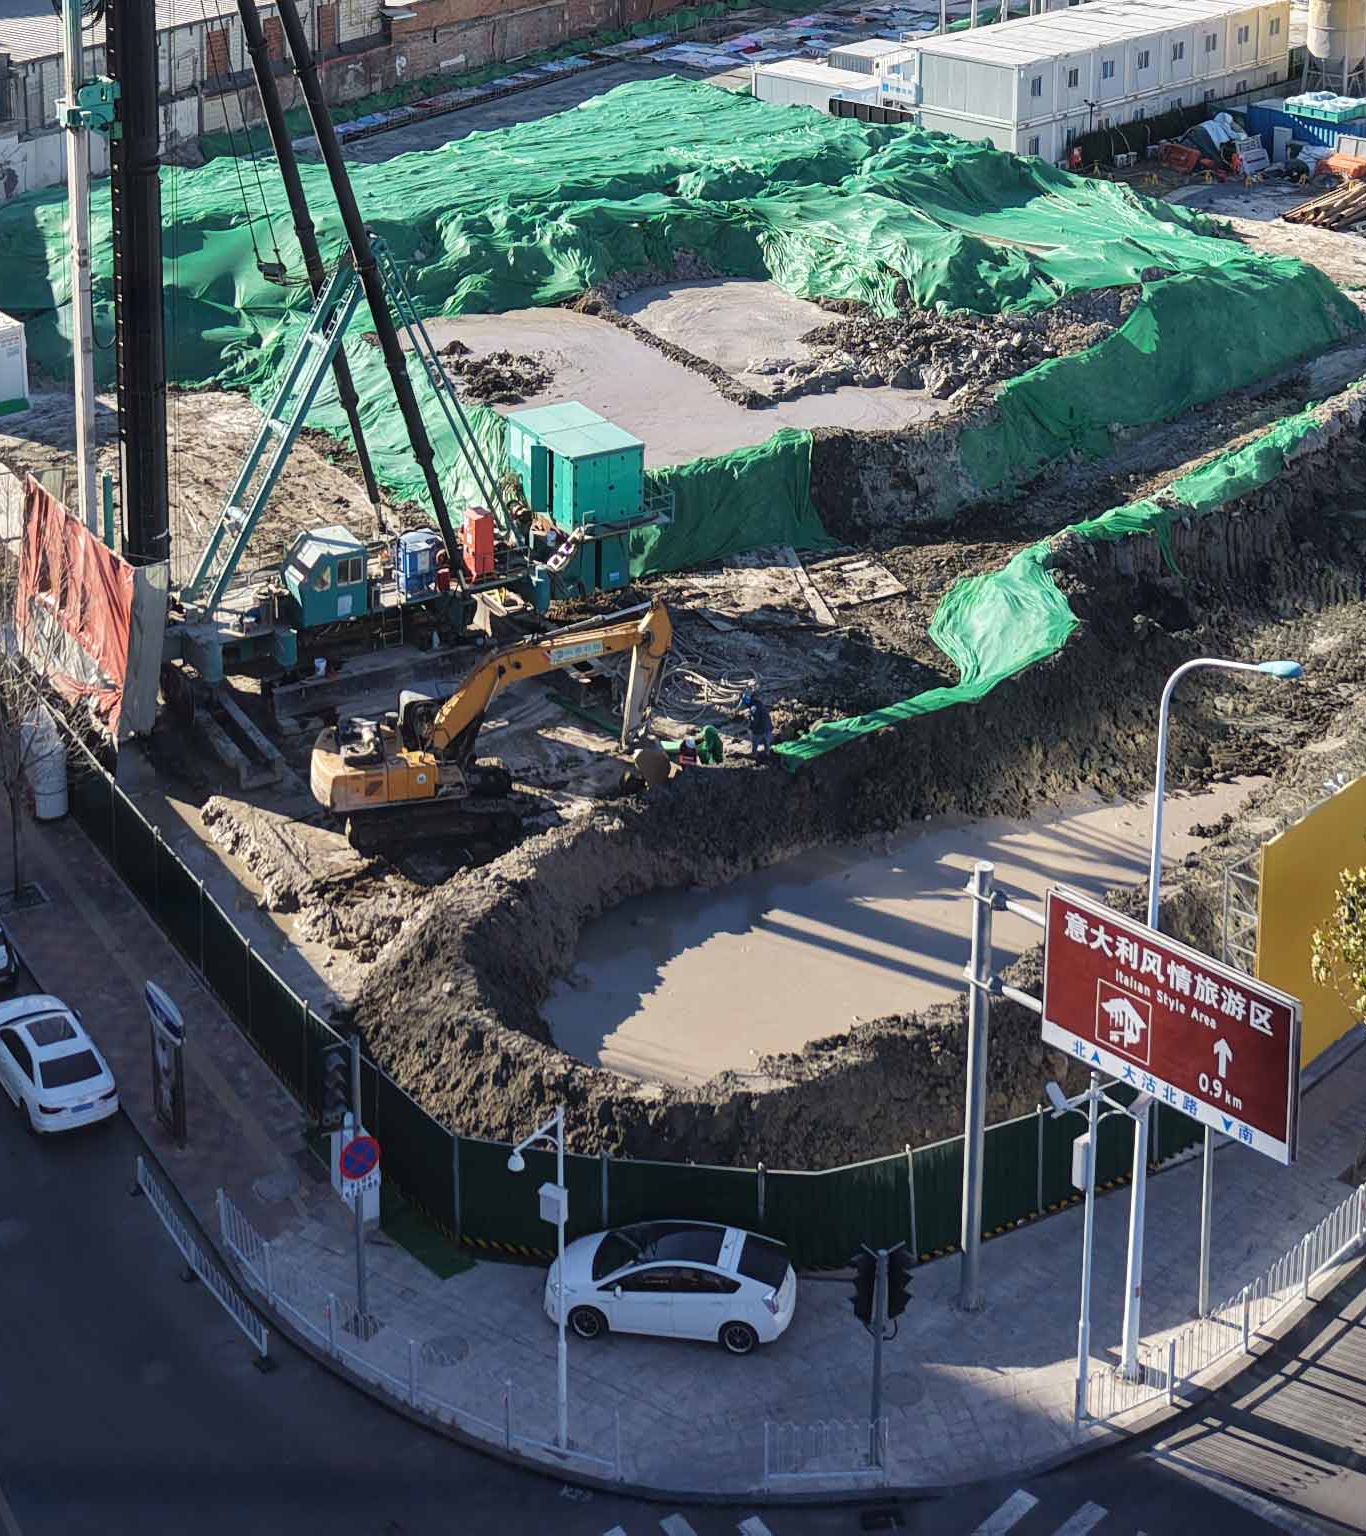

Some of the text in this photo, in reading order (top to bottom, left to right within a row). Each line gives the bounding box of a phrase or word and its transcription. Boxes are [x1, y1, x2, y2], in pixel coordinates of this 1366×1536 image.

[1063, 910, 1275, 1037] 意大利风情旅游区
[1114, 969, 1218, 1031] Italian Style Area
[1072, 1040, 1254, 1146] 北 大沽北路 南
[1197, 1072, 1244, 1112] 0.9 km
